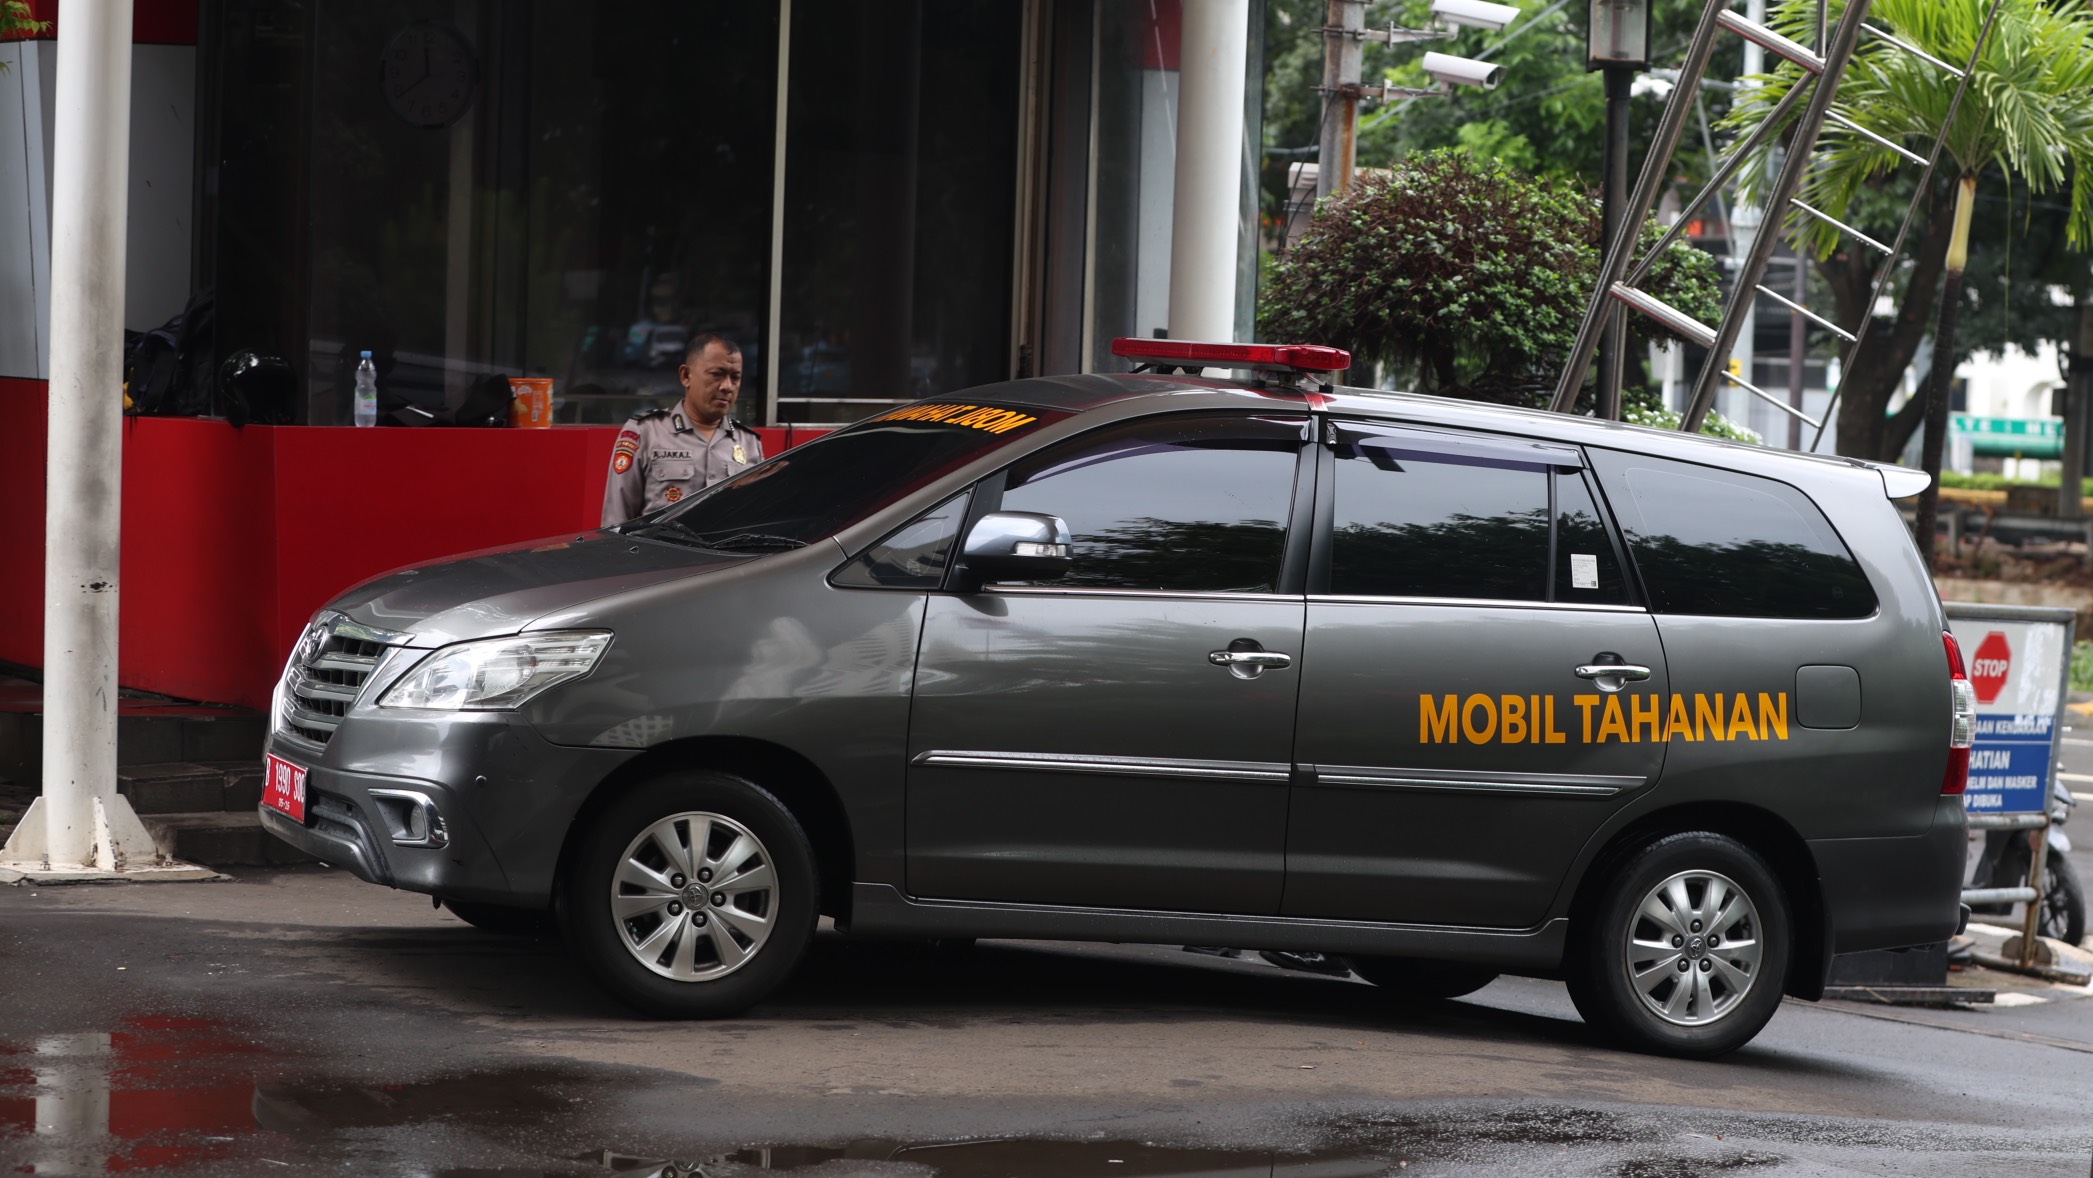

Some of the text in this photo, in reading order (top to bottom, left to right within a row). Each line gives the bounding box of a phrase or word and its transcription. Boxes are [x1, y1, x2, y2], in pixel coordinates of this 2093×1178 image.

[1973, 658, 2008, 677] STOP
[1419, 691, 1790, 745] MOBIL TAHANAN
[265, 757, 271, 787] B
[275, 761, 291, 797] 1990
[1987, 775, 2004, 790] DAN
[2004, 775, 2038, 790] MASKER
[1973, 794, 2003, 808] DIBUKA
